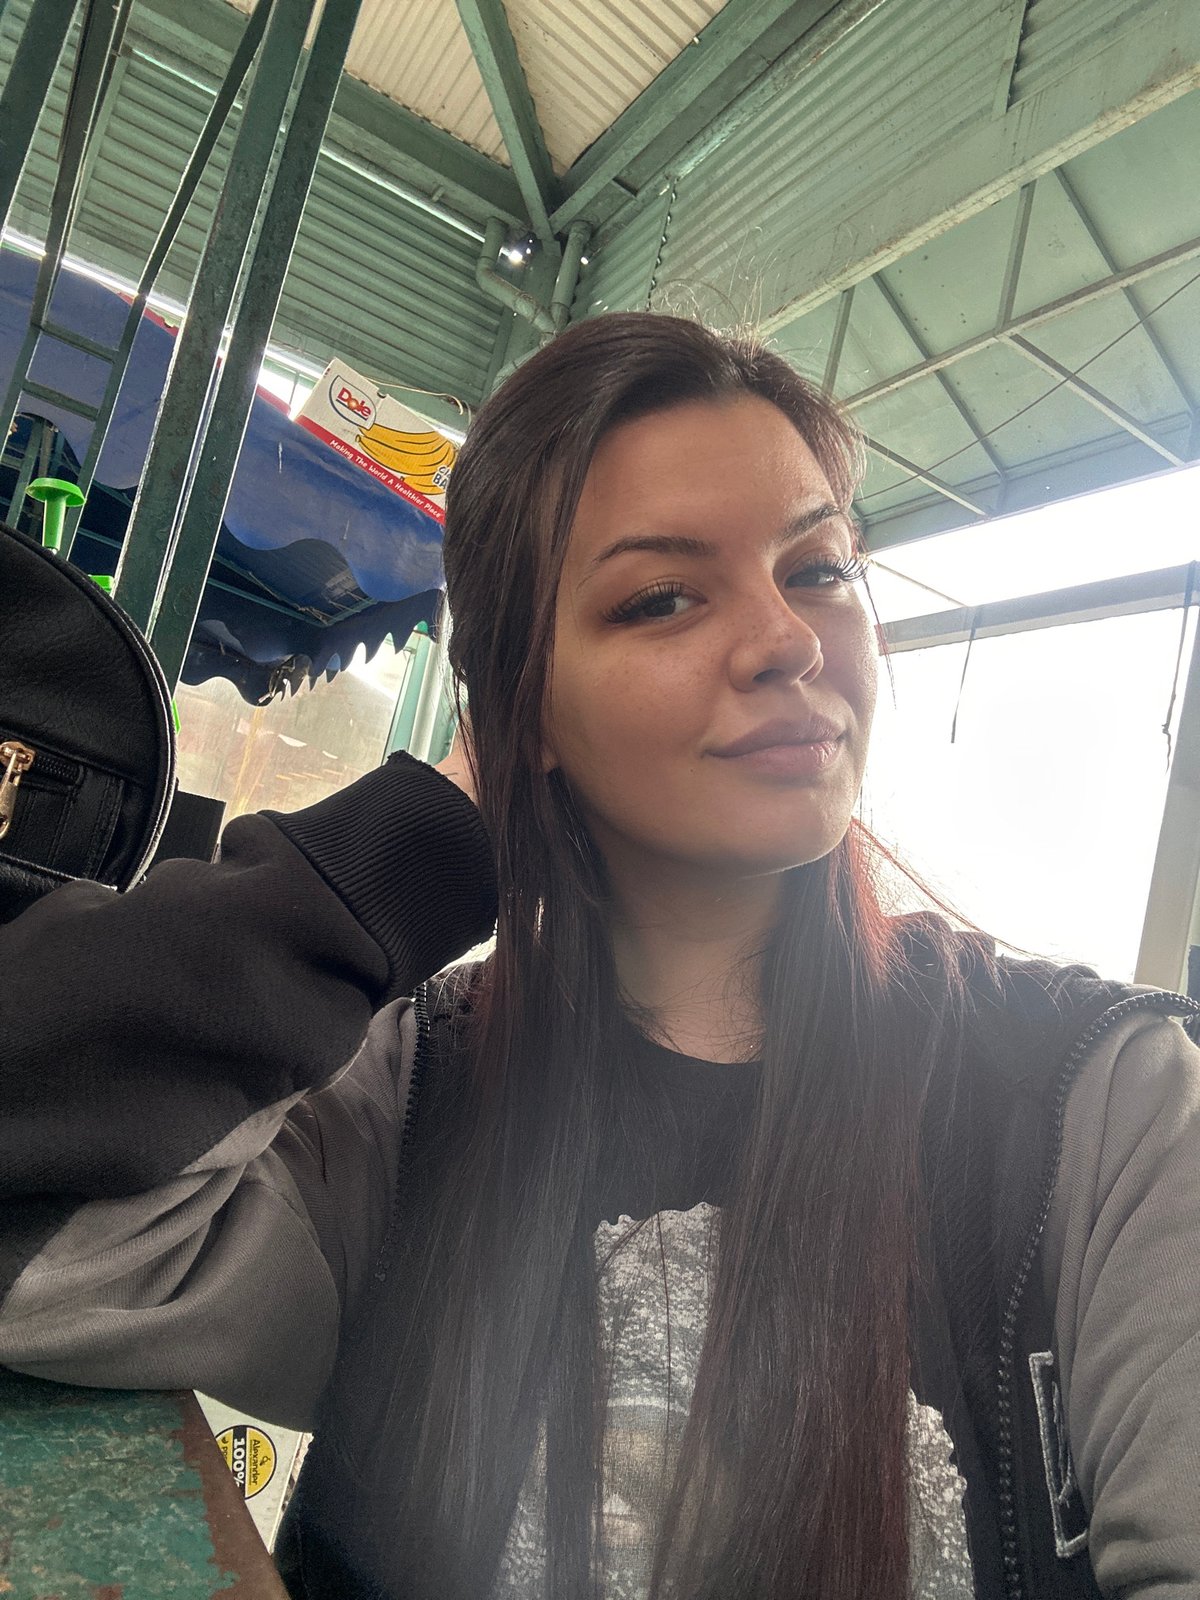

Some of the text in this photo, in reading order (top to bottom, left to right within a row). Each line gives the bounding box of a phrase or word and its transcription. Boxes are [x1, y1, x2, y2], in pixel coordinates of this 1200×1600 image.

[337, 387, 371, 417] Dole
[329, 439, 441, 518] Making The World A Healthier Place
[252, 1439, 260, 1485] Alexander
